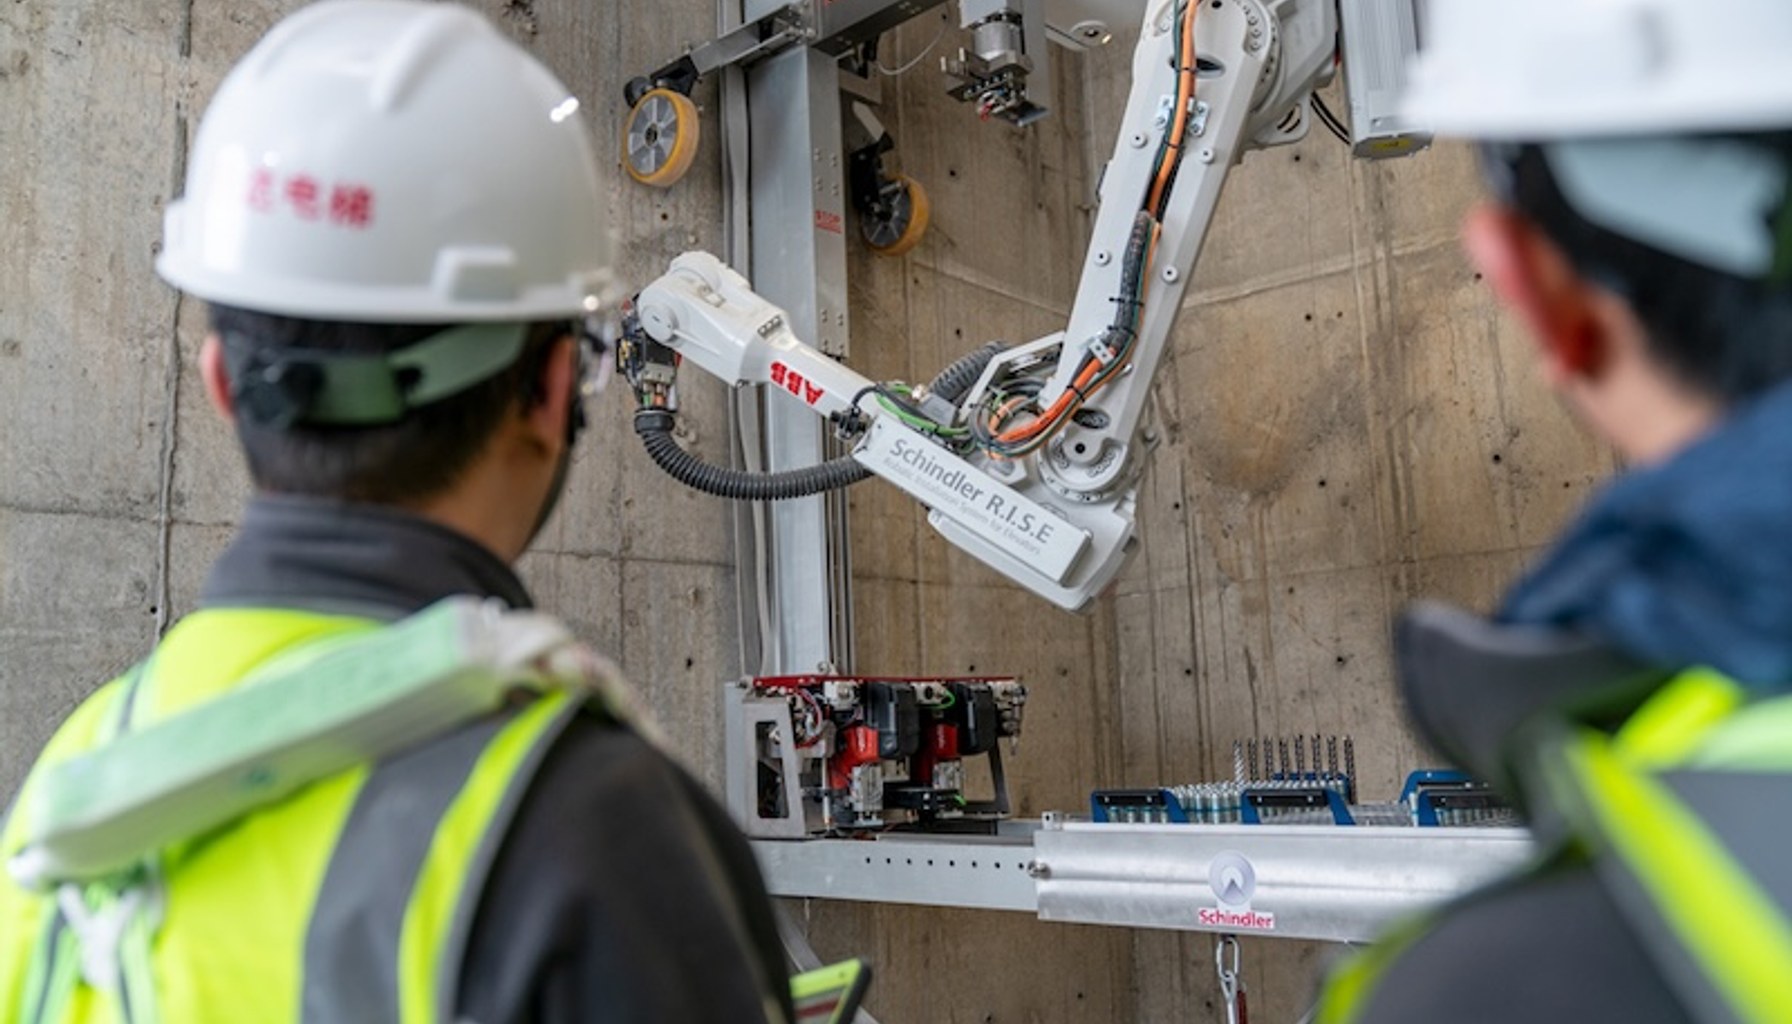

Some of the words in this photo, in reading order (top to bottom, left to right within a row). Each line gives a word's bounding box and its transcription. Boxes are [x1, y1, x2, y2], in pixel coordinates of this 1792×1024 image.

[771, 362, 824, 405] ABB
[890, 439, 983, 500] Schindler
[985, 494, 1053, 543] R.I.S.E
[1199, 909, 1272, 928] Schindler
